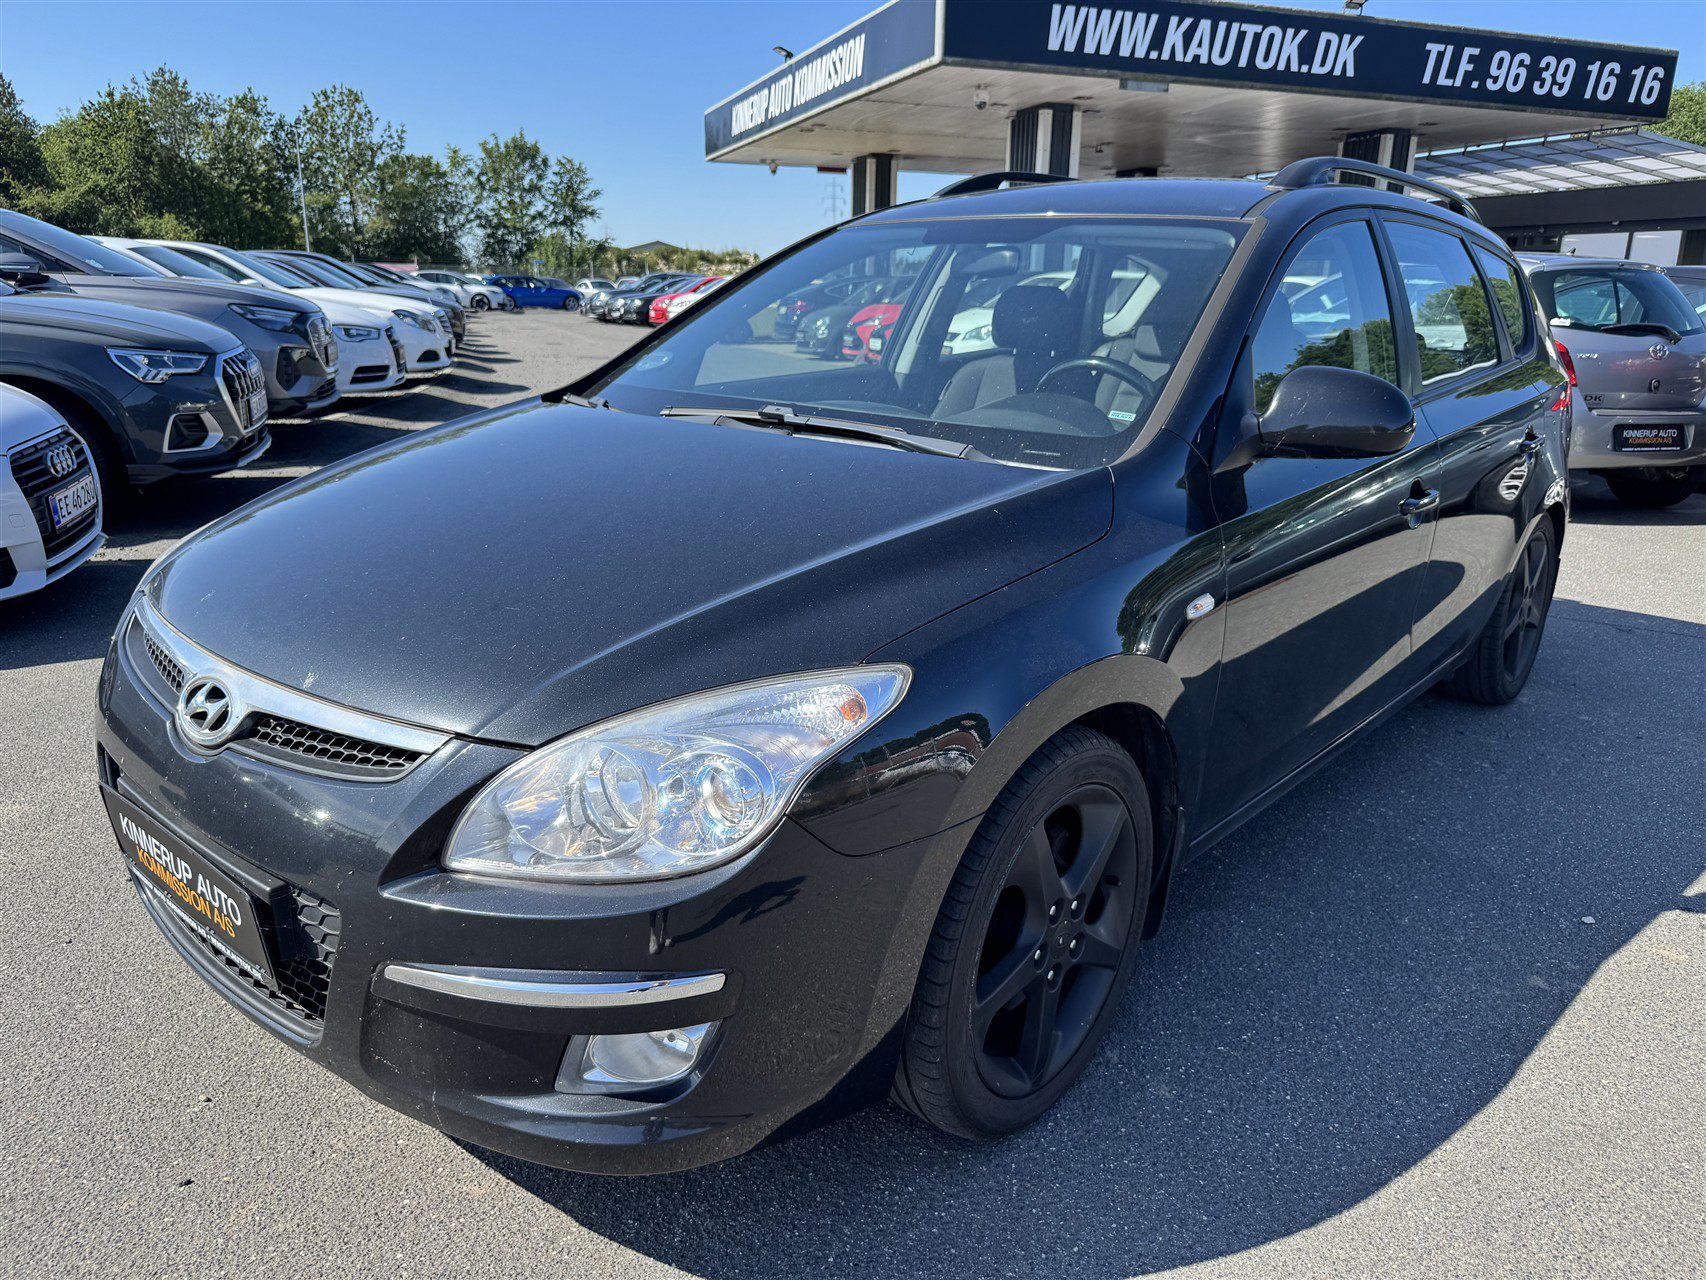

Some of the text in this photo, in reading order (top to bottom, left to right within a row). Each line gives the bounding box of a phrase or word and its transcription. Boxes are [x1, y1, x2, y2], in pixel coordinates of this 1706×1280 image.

[731, 33, 866, 137] KINNERUP AUTO KOMMISSION
[1047, 4, 1665, 105] WWW.KAUTOK.DK TLF. 96 39 16 16
[1623, 429, 1678, 438] KINNERUP AUTO
[57, 495, 72, 519] EE
[119, 812, 193, 885] KINNERUP
[196, 872, 242, 927] AUTO
[136, 845, 212, 920] KOMMISSION
[214, 907, 236, 938] A/S
